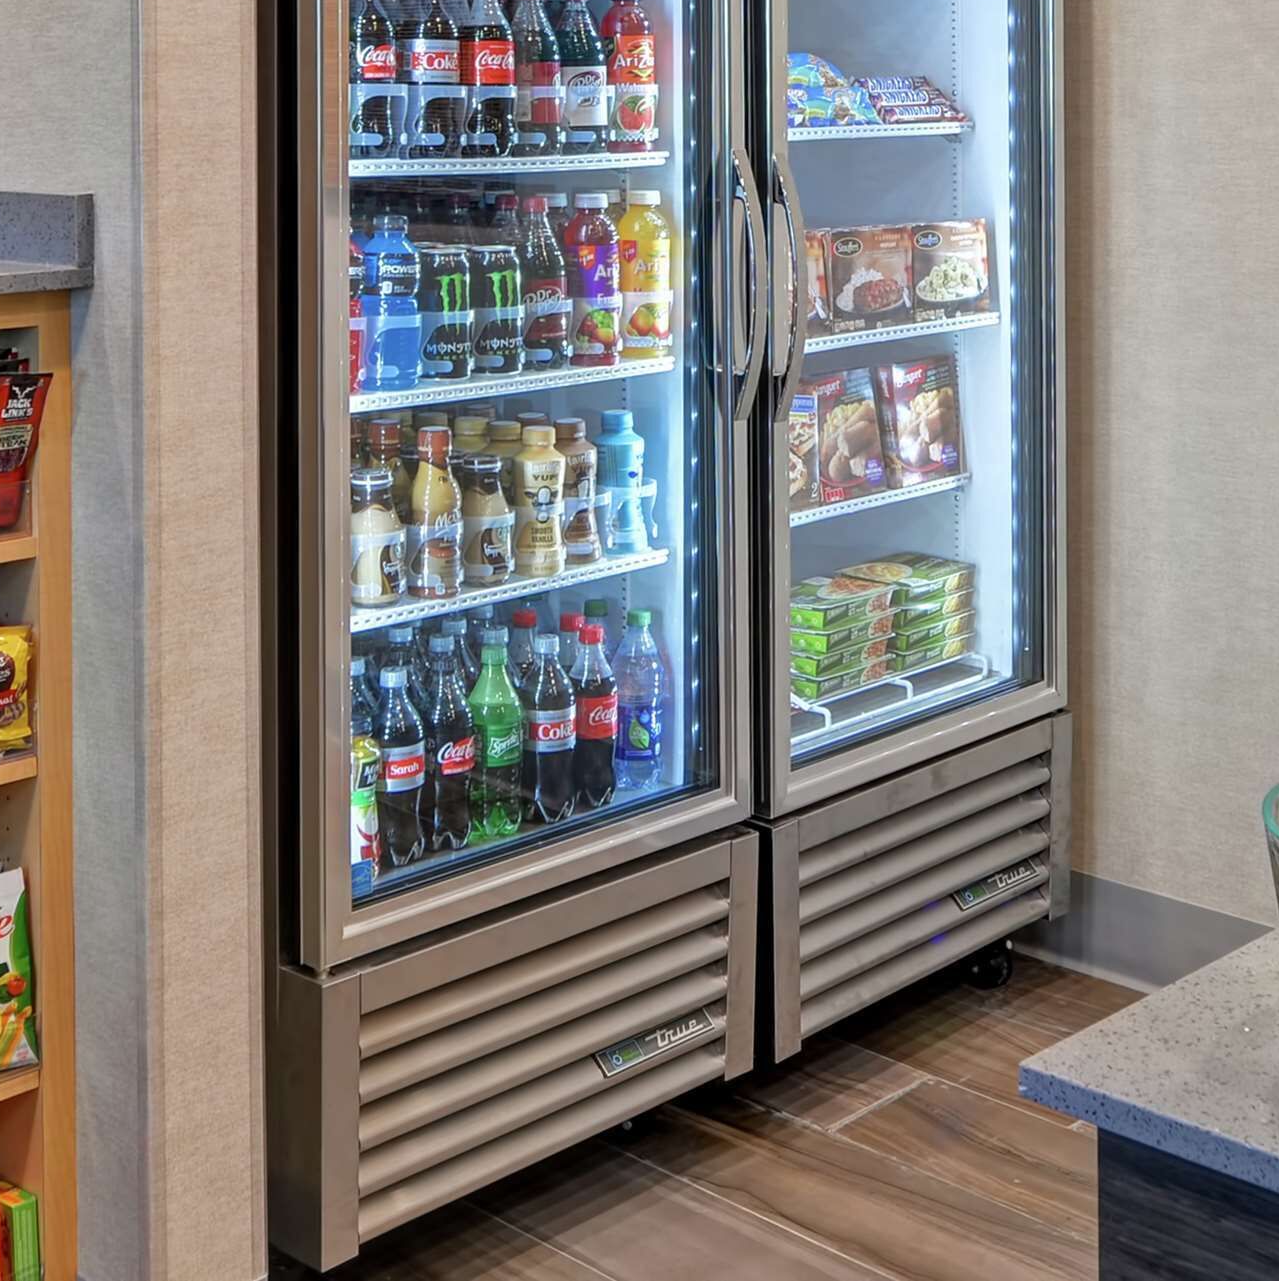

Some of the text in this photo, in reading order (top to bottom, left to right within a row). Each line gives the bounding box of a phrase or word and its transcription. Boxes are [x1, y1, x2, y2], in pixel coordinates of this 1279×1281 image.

[423, 54, 458, 70] Coke
[426, 342, 470, 354] MONST
[479, 336, 522, 349] MONST
[7, 398, 32, 409] JACK
[537, 724, 574, 740] Coke
[491, 733, 519, 754] Sprite
[389, 760, 420, 777] Sarah
